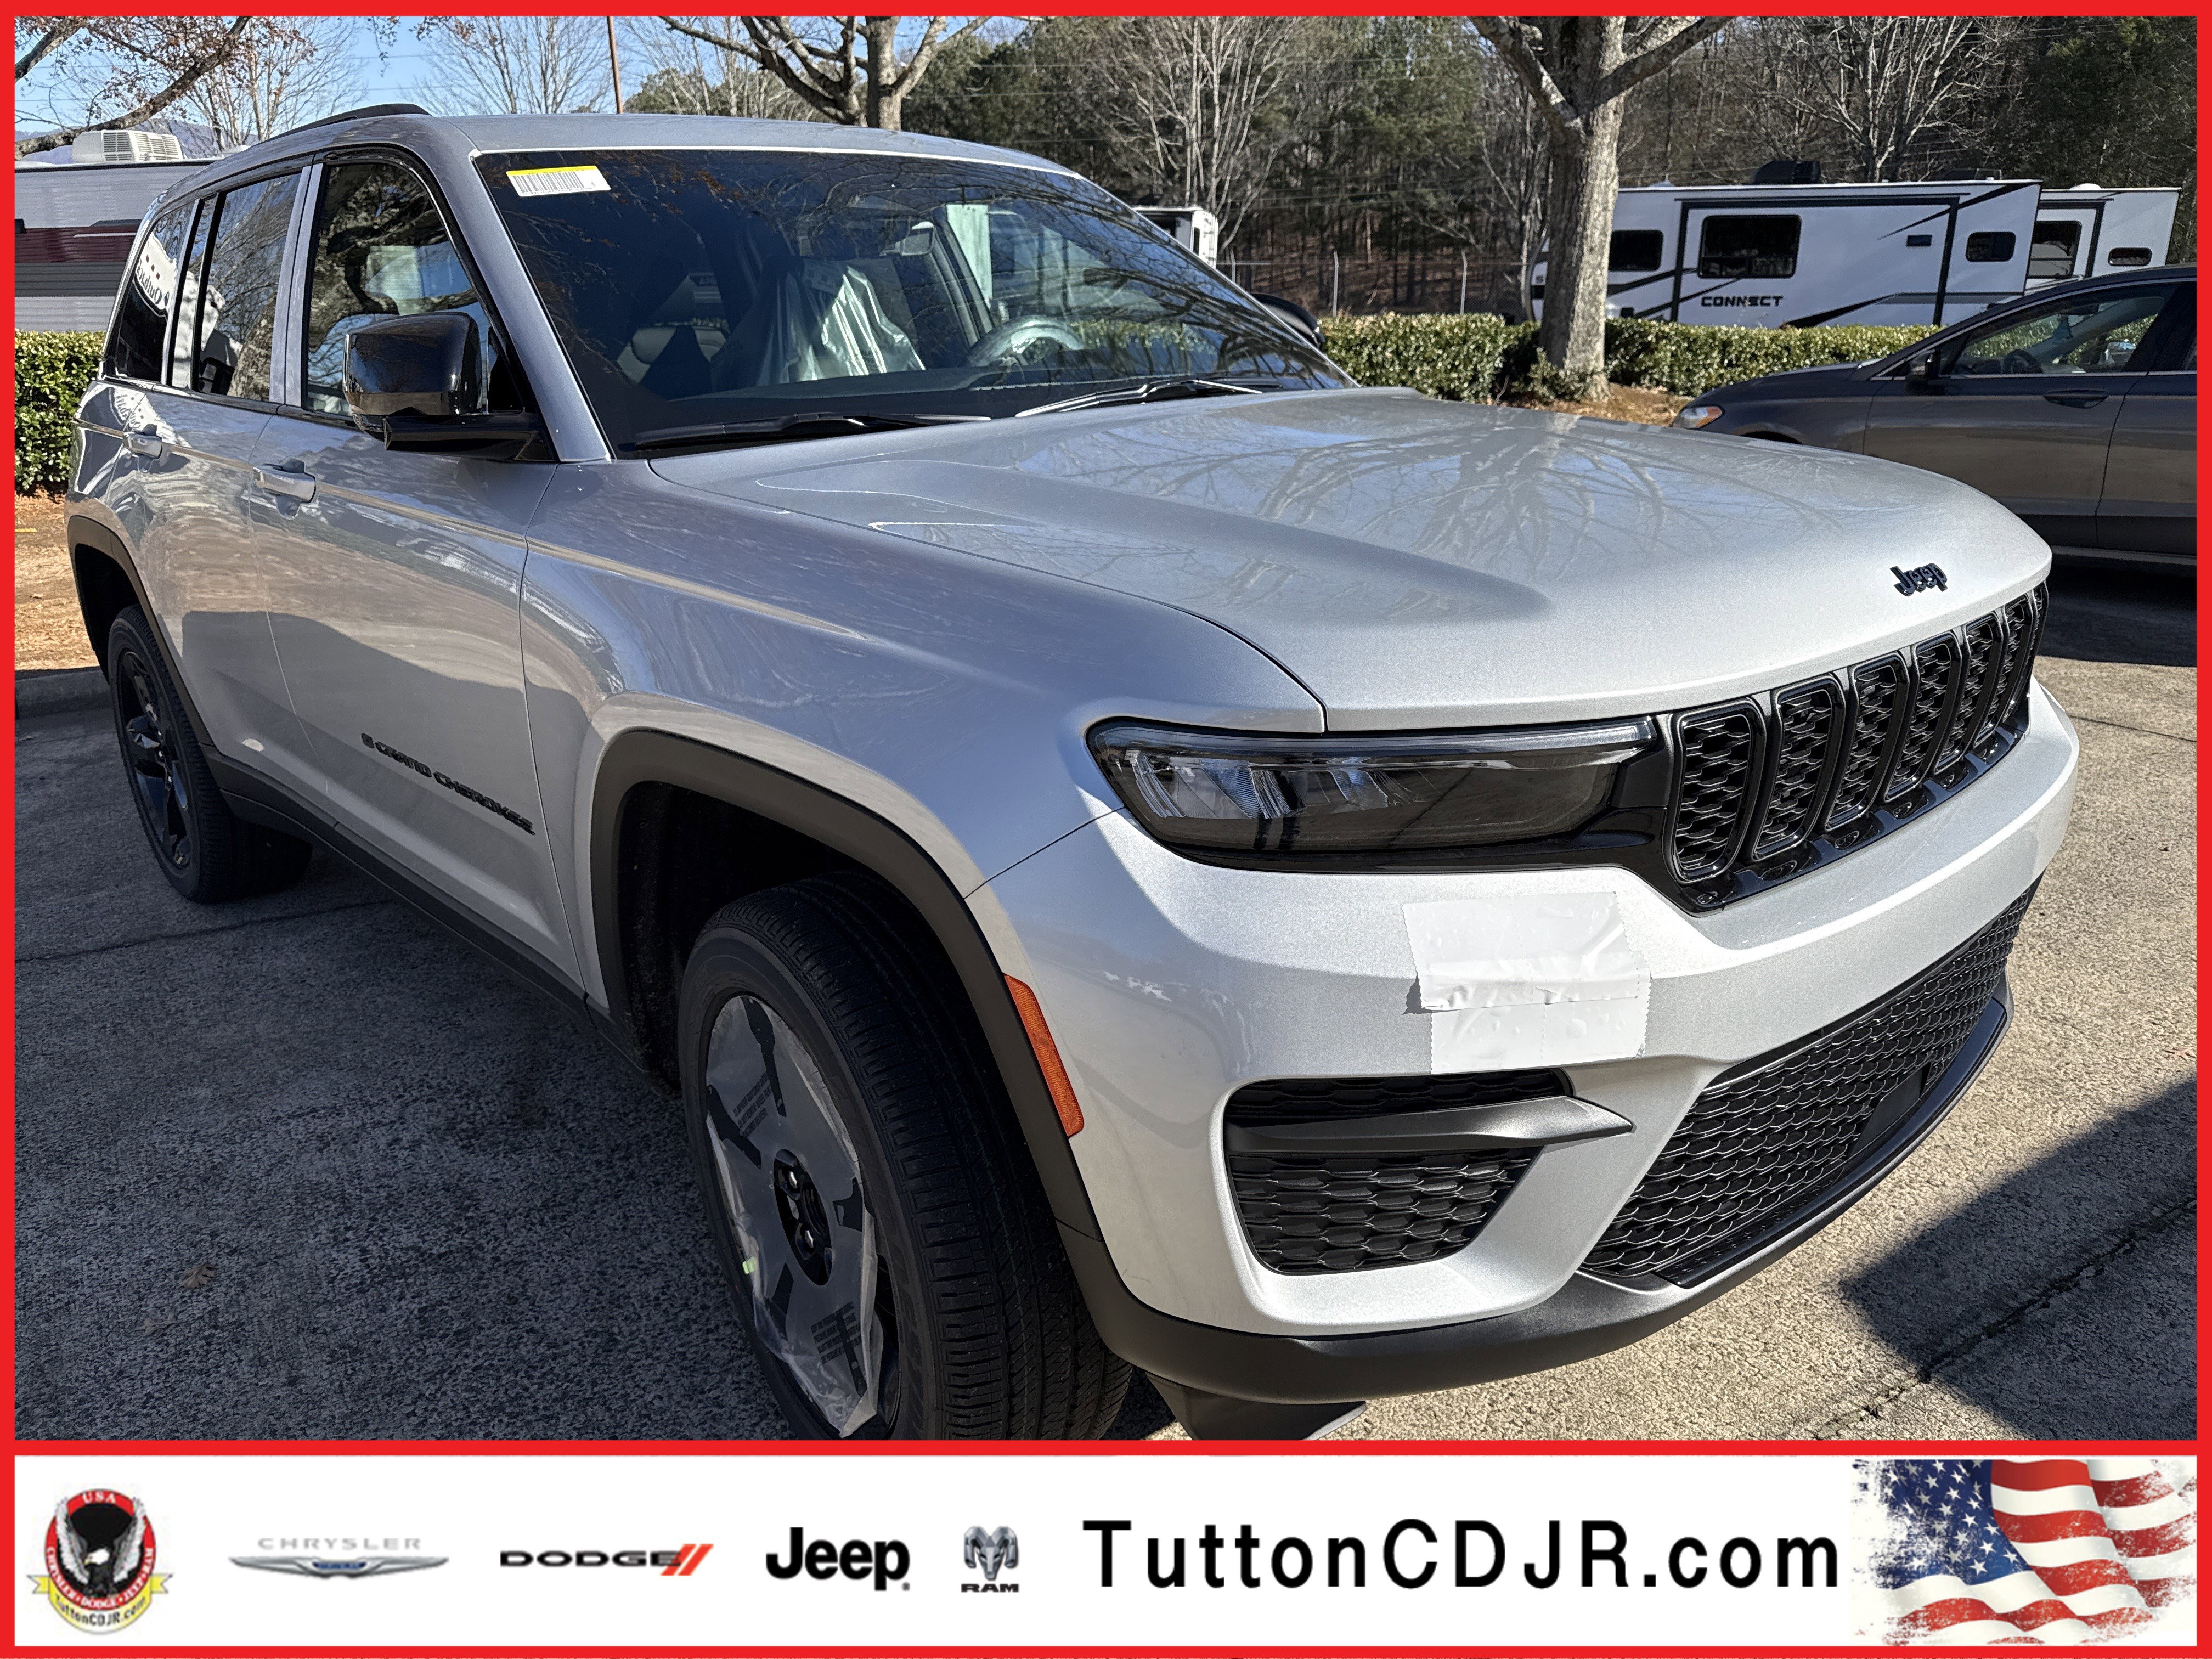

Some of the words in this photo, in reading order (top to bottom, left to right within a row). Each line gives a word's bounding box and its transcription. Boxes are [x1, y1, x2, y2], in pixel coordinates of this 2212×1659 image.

[1701, 295, 1784, 307] CONNECT
[1889, 563, 1948, 597] Jeep
[375, 741, 432, 777] GRAND
[433, 771, 535, 836] CHEROKEE
